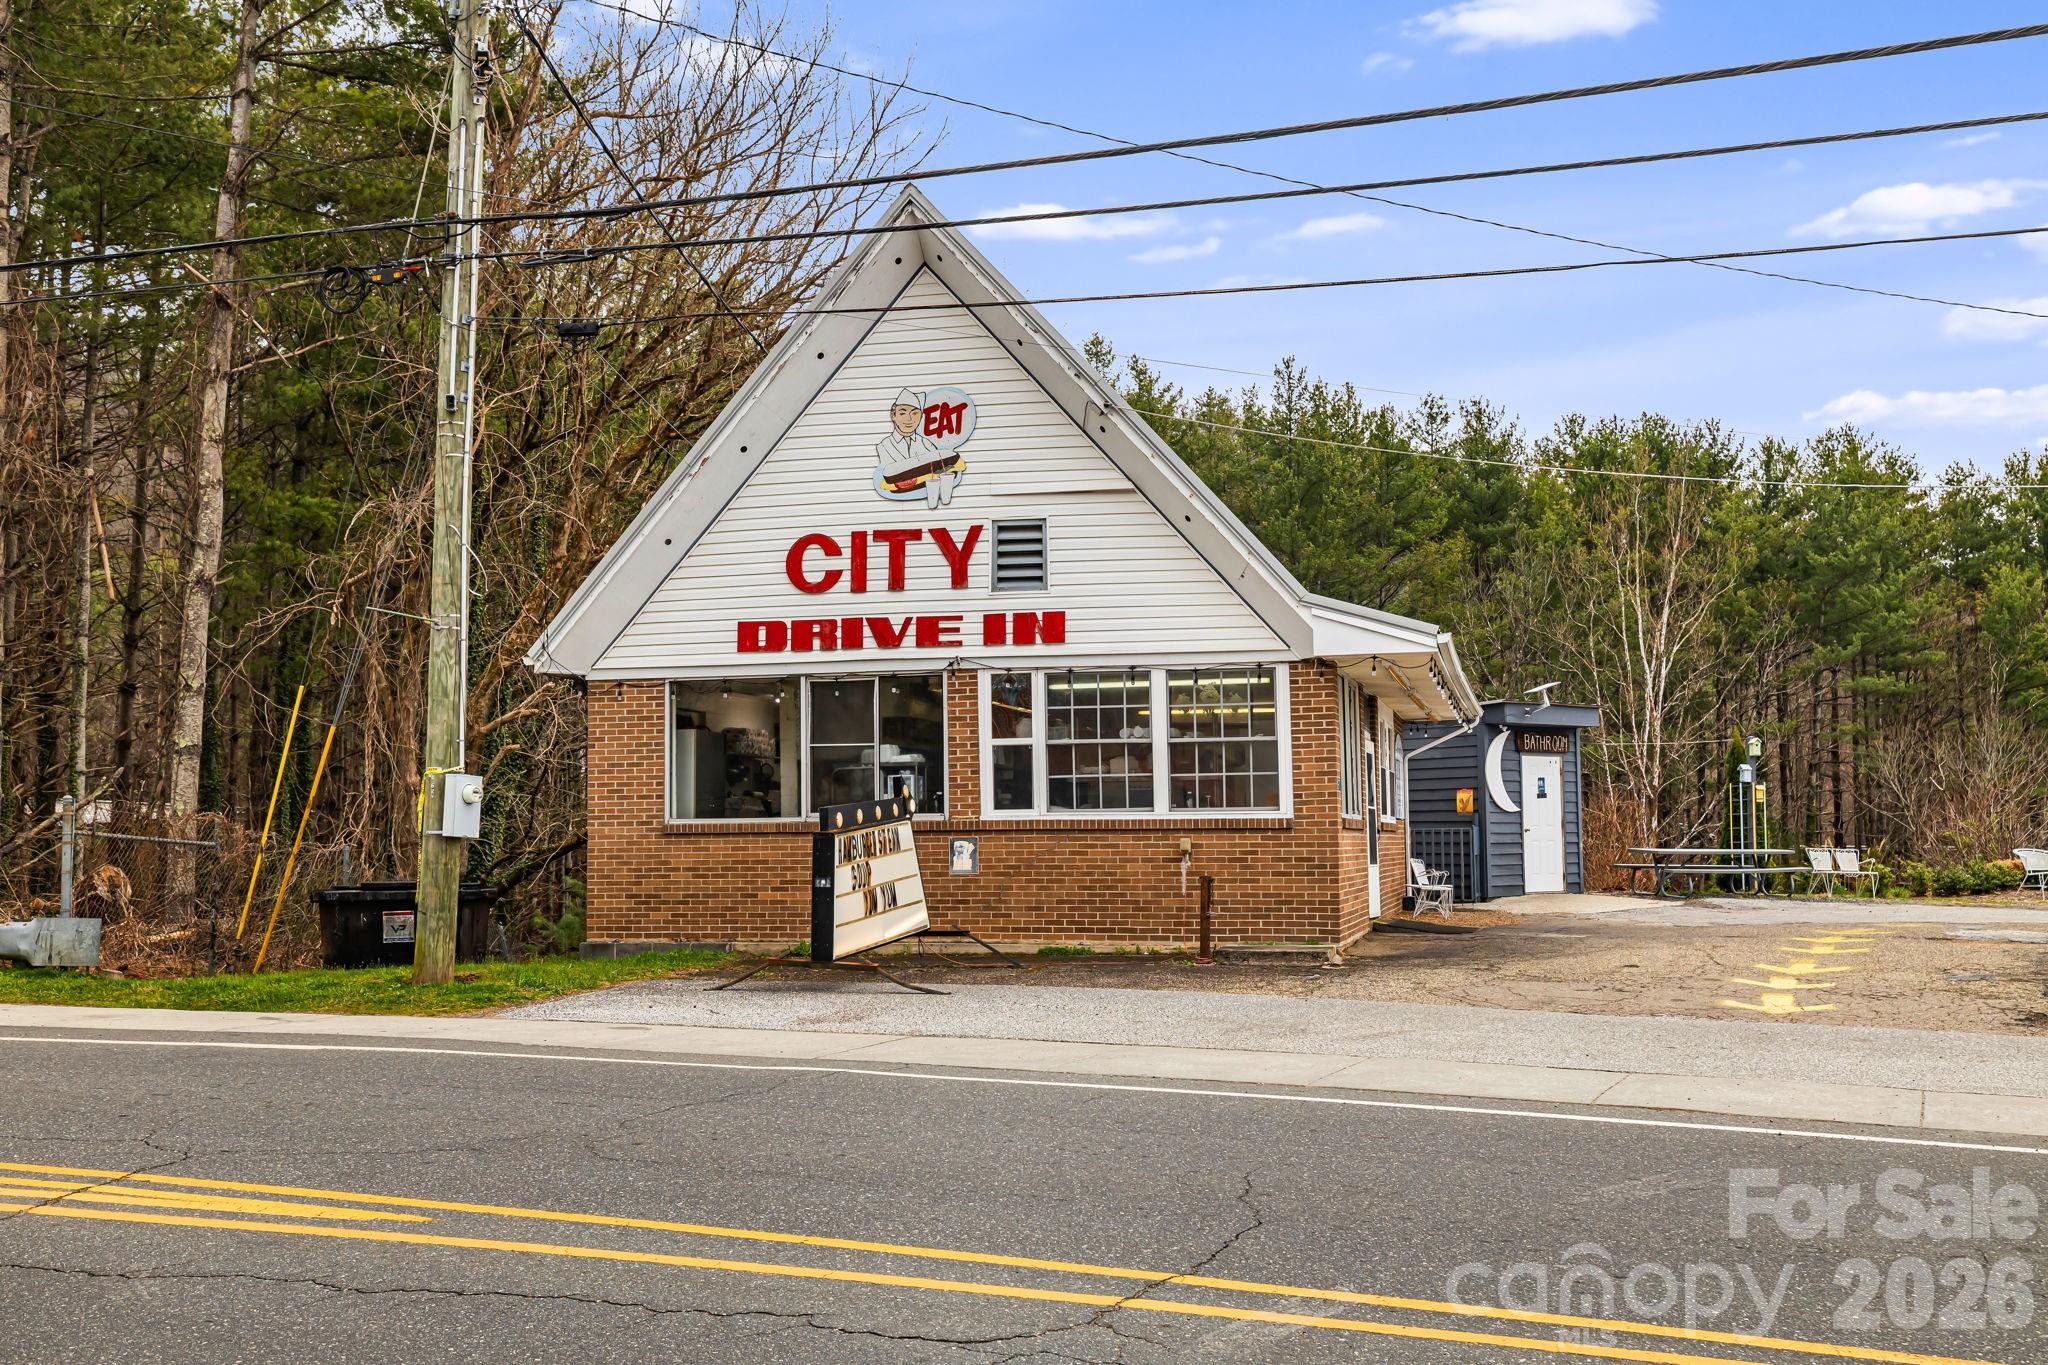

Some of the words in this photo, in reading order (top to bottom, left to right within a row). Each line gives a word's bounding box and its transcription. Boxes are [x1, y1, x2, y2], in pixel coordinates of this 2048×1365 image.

[923, 402, 968, 439] EAT
[786, 525, 984, 594] CITY
[737, 615, 964, 653] DRIVE
[983, 611, 1066, 647] IN
[1524, 734, 1568, 751] BATHROOM
[851, 861, 872, 891] SOUP
[880, 882, 898, 911] YUM
